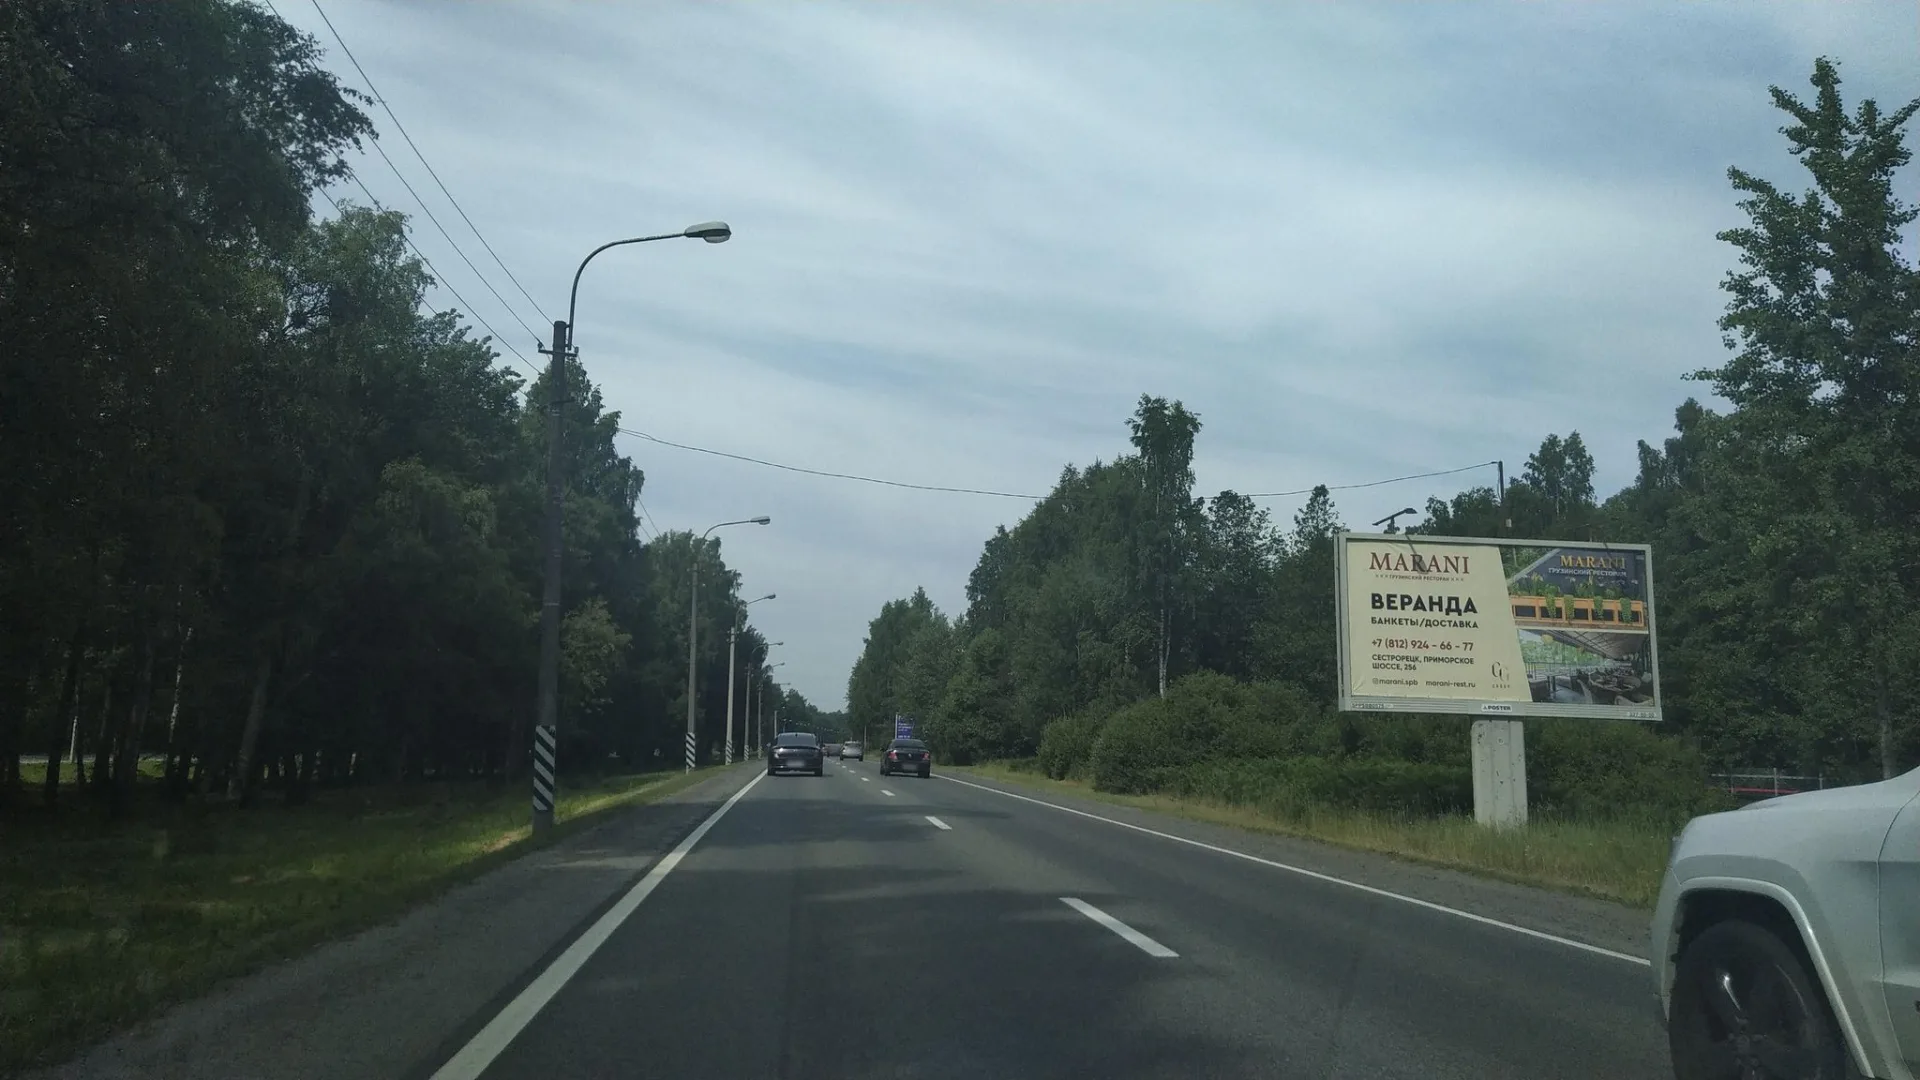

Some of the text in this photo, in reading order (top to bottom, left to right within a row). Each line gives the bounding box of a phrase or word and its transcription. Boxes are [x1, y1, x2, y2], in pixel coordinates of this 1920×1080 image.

[1369, 552, 1470, 574] MARANI
[1560, 555, 1625, 569] MARANI
[1548, 567, 1589, 576] ГРУЗИНСКИЙ
[1371, 593, 1478, 616] ВЕРАНДА
[1371, 616, 1479, 629] БАНКЕТЫ/ДОСТАВКА
[1371, 638, 1382, 648] +7
[1385, 638, 1408, 650] (812)
[1411, 640, 1429, 650] 924
[1439, 641, 1452, 651] 66
[1462, 642, 1474, 651] 77
[1371, 654, 1474, 665] СЕСТРОРЕЦК, ПРИМОРСКОЕ
[1372, 663, 1402, 671] ШОССЕ,
[1425, 679, 1476, 688] marani-rest.ru
